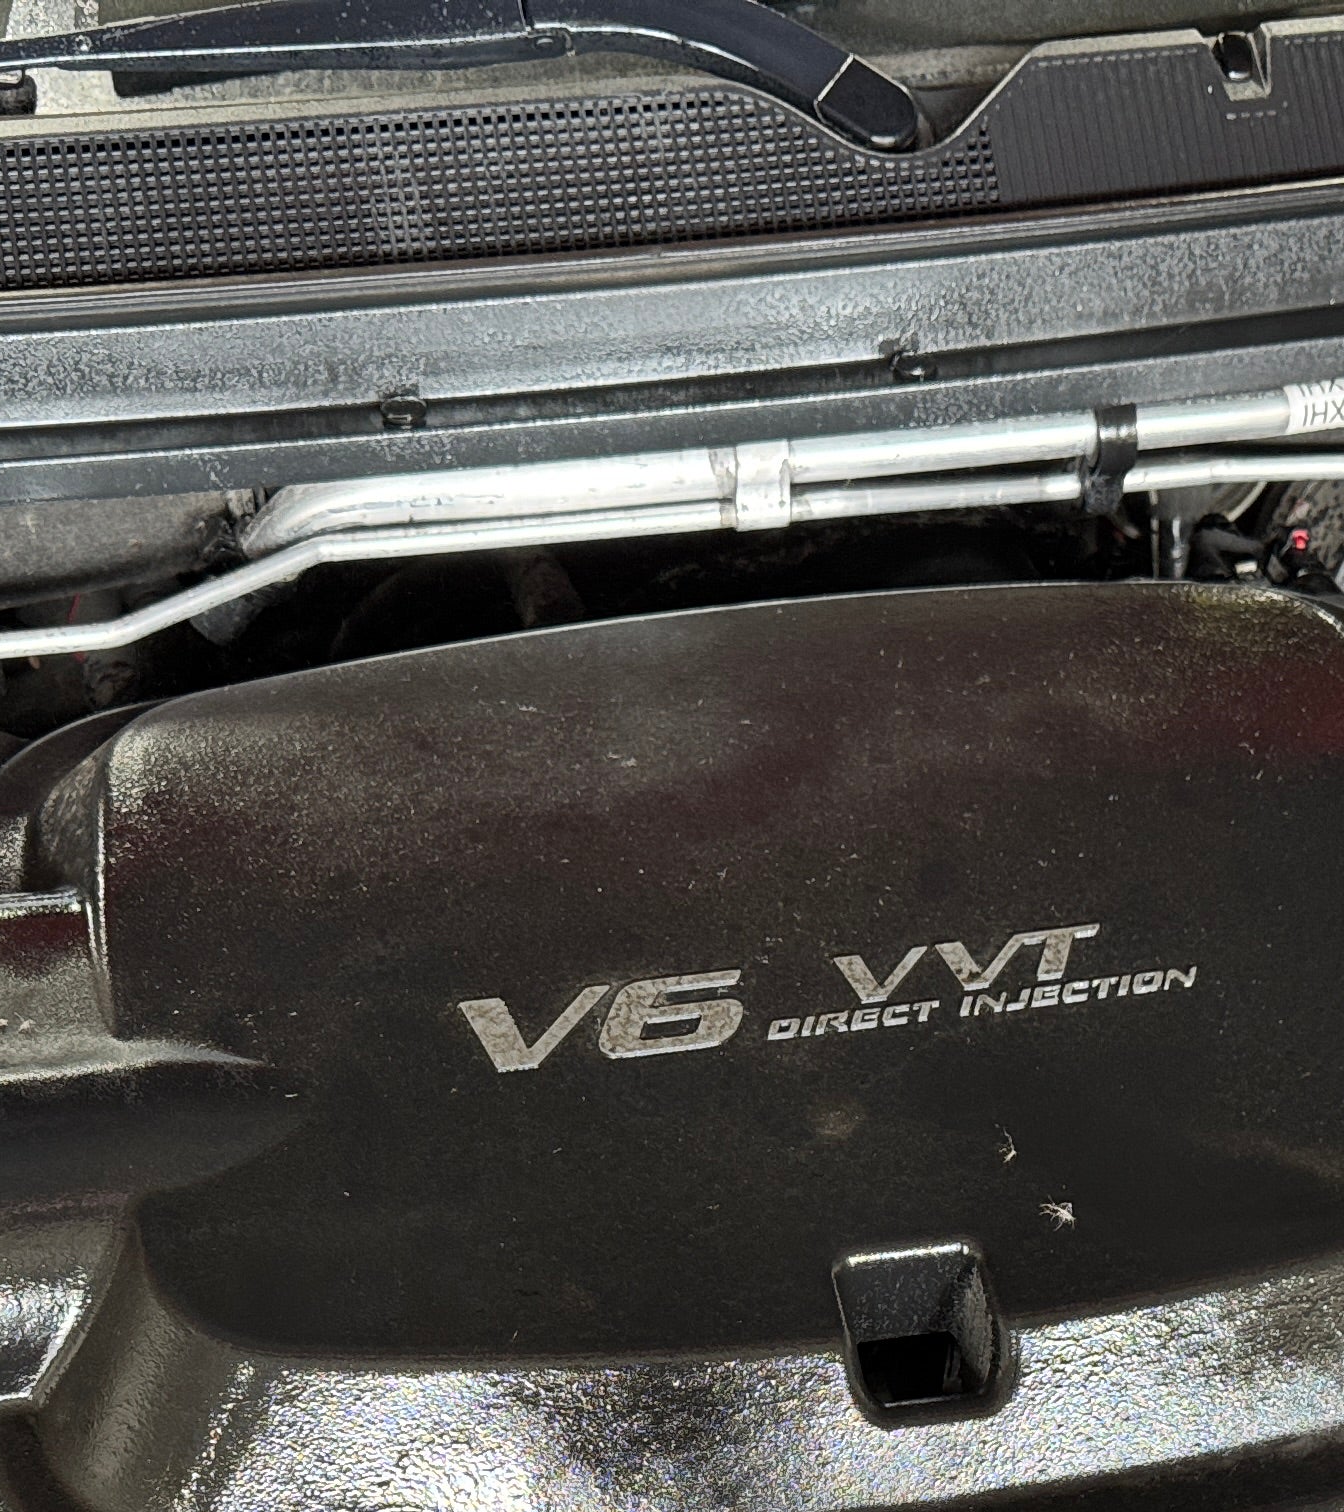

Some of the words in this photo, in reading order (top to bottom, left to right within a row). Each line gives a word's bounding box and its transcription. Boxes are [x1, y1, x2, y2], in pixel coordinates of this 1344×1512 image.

[766, 999, 940, 1041] DIRECT
[958, 966, 1199, 1018] INJECTION
[832, 922, 1100, 1004] VVT
[457, 968, 743, 1072] V6
